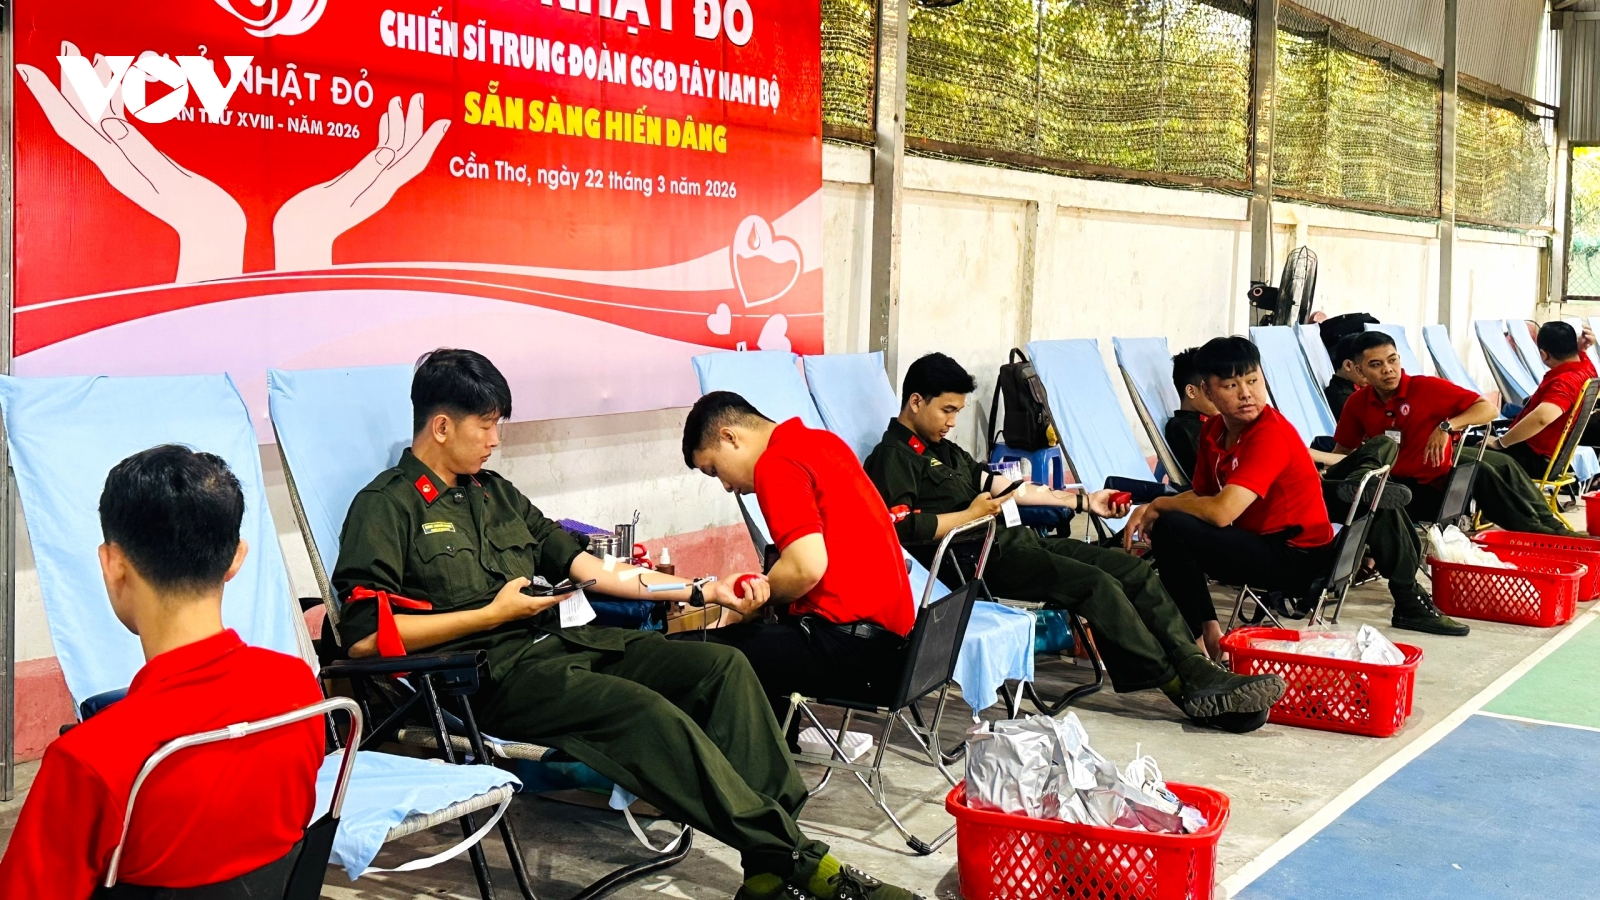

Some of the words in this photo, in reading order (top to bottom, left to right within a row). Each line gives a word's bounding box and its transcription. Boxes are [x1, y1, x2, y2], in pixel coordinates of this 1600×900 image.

[379, 6, 459, 58] CHIẾN
[463, 19, 487, 62] SĨ
[489, 29, 566, 75] TRUNG
[568, 42, 627, 85] ĐOÀN
[630, 55, 677, 92] CSCĐ
[680, 59, 716, 98] TÂY
[718, 70, 756, 105] NAM
[758, 74, 780, 115] BỘ
[330, 68, 374, 109] ĐỎ
[237, 111, 274, 130] XVIII
[287, 114, 323, 136] NĂM
[326, 121, 361, 139] 2026
[464, 80, 524, 130] SẴN
[528, 95, 601, 139] SÀNG
[605, 105, 661, 146] HIẾN
[666, 115, 727, 153] DÂNG
[449, 151, 489, 180] Cần
[494, 160, 532, 187] Thơ,
[537, 165, 580, 190] ngày
[584, 168, 604, 188] 22
[608, 169, 653, 197] tháng
[657, 175, 666, 193] 3
[670, 177, 701, 196] năm
[705, 179, 738, 199] 2026
